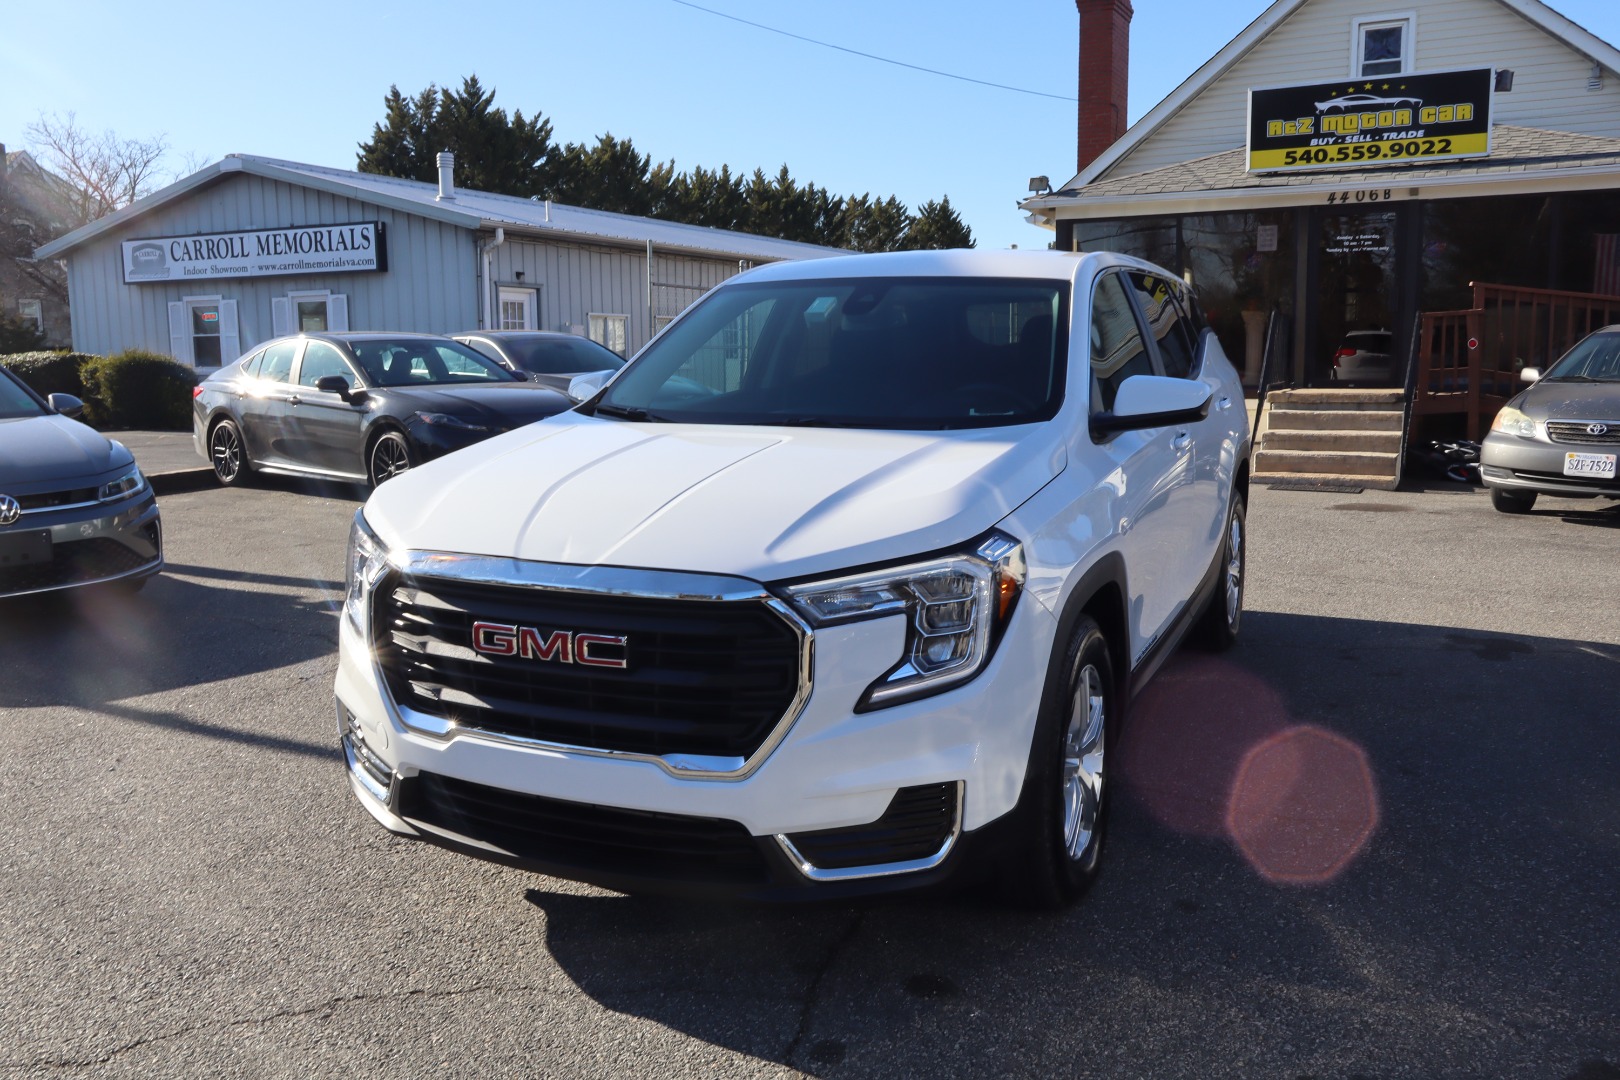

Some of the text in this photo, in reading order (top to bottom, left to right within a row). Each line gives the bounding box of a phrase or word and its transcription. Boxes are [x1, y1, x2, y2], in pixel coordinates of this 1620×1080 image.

[1309, 130, 1425, 147] BUY SELL TRADE
[1284, 139, 1452, 166] 540.559.9022
[1327, 188, 1391, 204] 4406B
[170, 227, 371, 262] CARROLL MEMORIALS
[183, 257, 375, 276] Indoor Showroom www.carrollmemorialsva.com
[1568, 459, 1614, 472] SZF-7522
[472, 621, 628, 669] GMC
